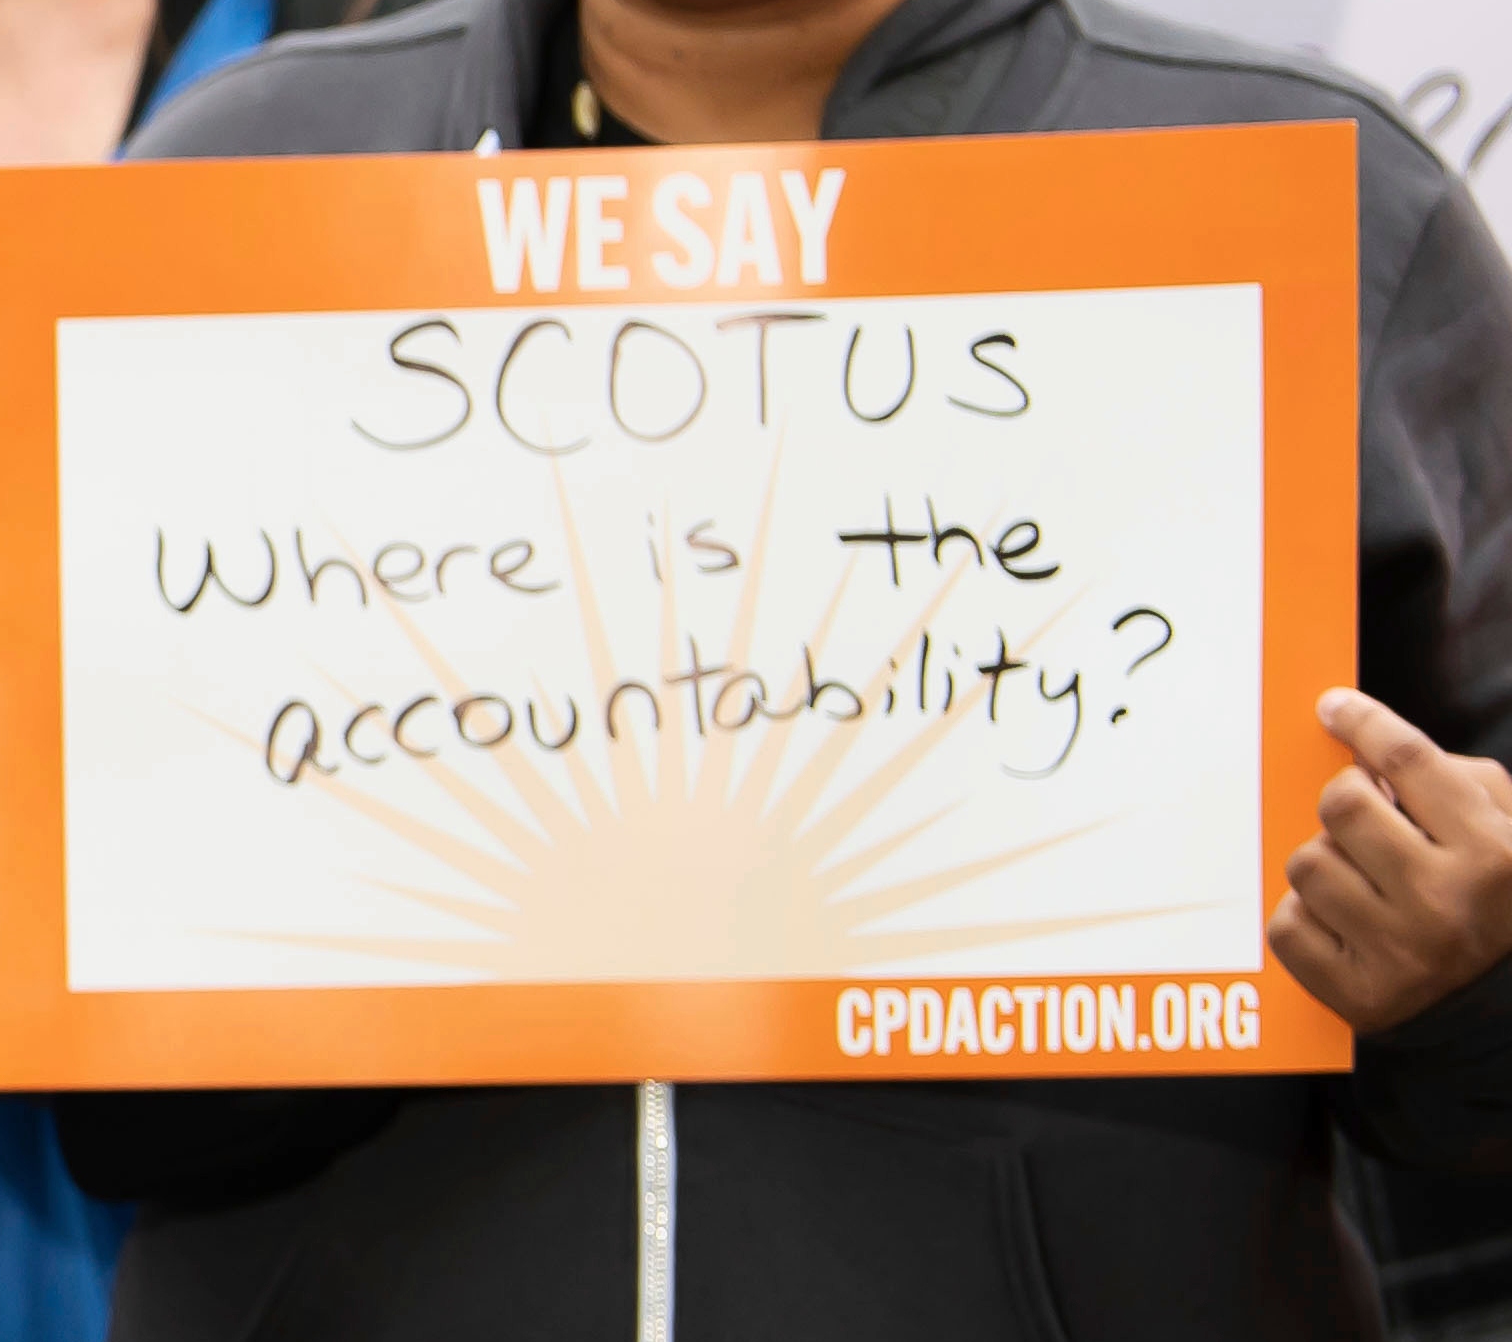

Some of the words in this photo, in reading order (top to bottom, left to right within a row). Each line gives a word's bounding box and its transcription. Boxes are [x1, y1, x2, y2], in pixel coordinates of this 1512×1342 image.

[475, 175, 628, 294] WE
[651, 167, 847, 289] SAY
[351, 312, 1031, 455] SCOTUS
[646, 509, 741, 583] is
[837, 493, 1061, 588] the
[265, 605, 1174, 786] accountability?
[835, 983, 1261, 1058] CPDACTION.ORG
